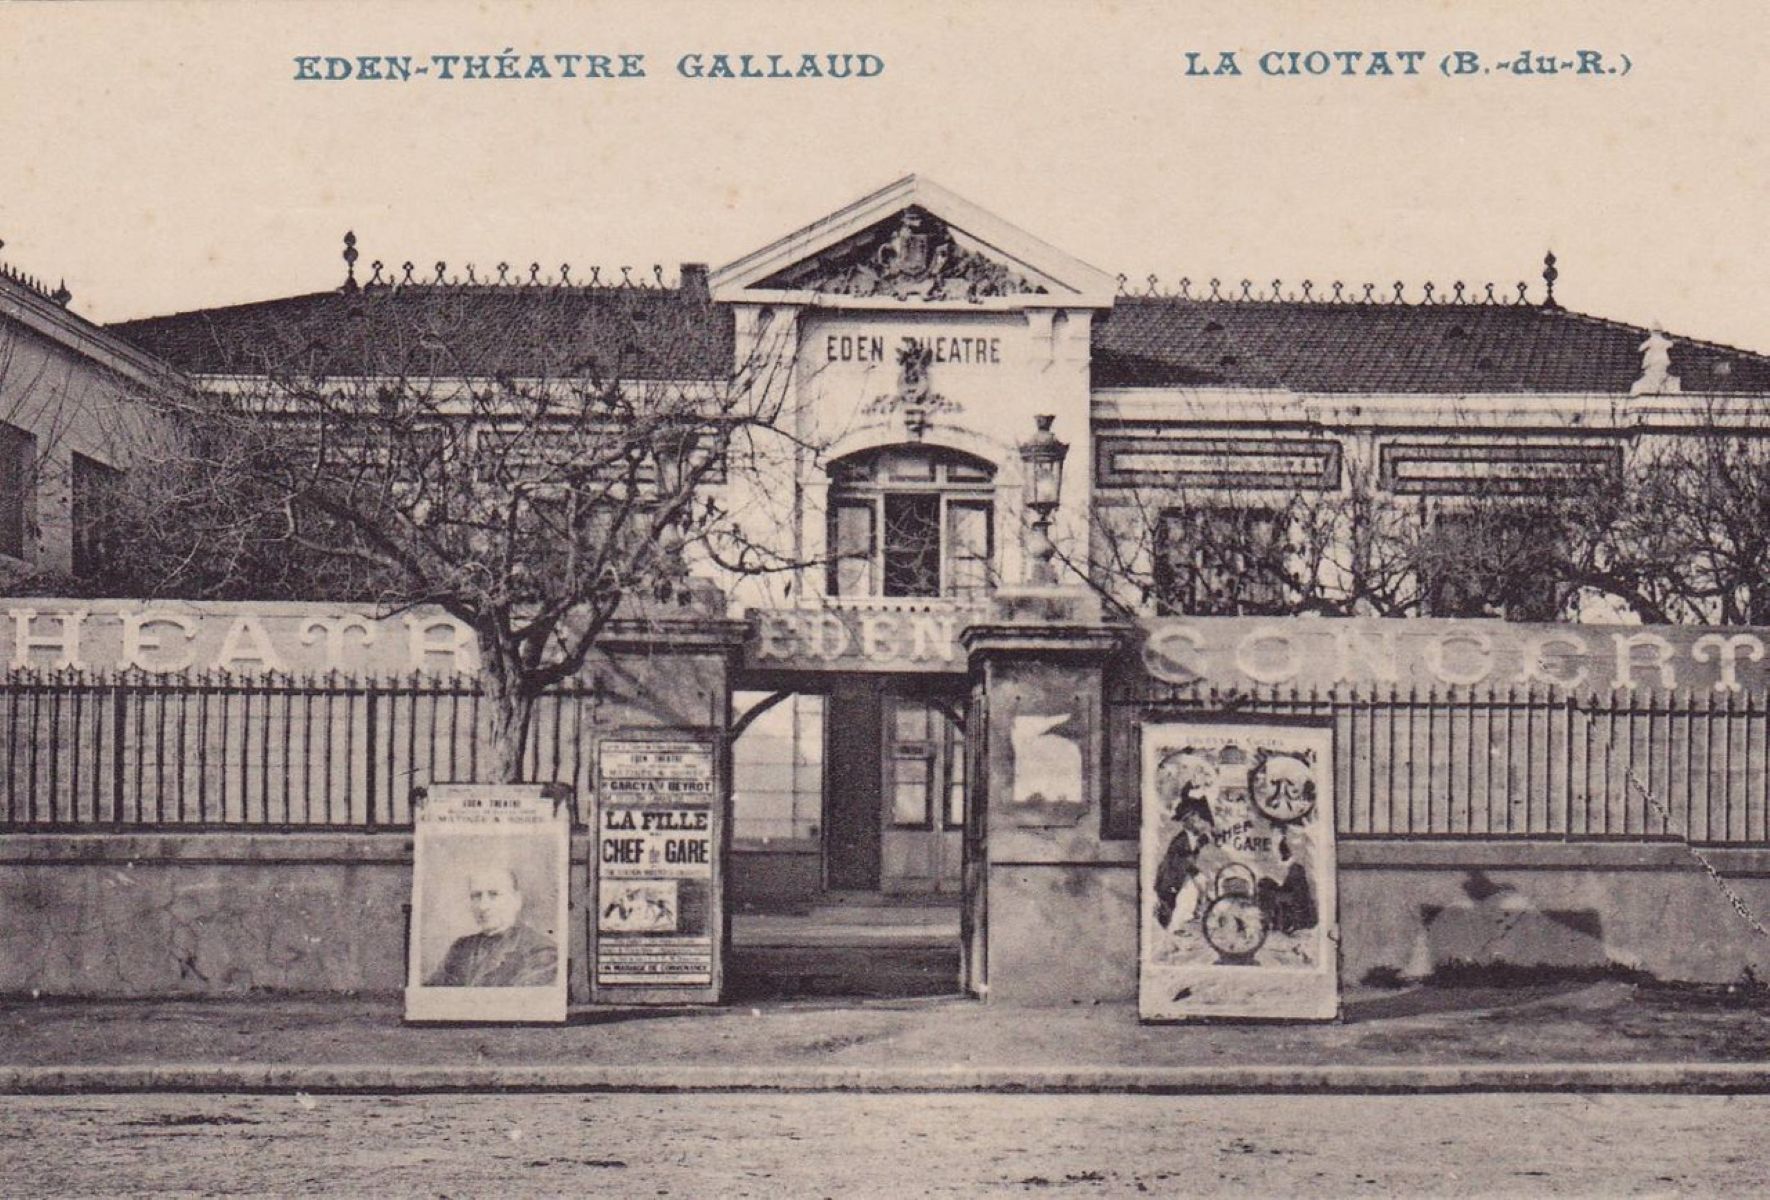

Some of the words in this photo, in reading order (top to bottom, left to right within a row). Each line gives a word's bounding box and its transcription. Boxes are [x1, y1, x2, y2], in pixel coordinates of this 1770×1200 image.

[827, 336, 884, 362] EDEN
[757, 612, 958, 663] EDEN
[1141, 624, 1765, 692] CONCERT
[606, 810, 636, 830] LA
[641, 811, 708, 831] FILLE
[602, 838, 645, 864] CHEF
[664, 839, 709, 864] GARE
[1232, 836, 1272, 852] GARE
